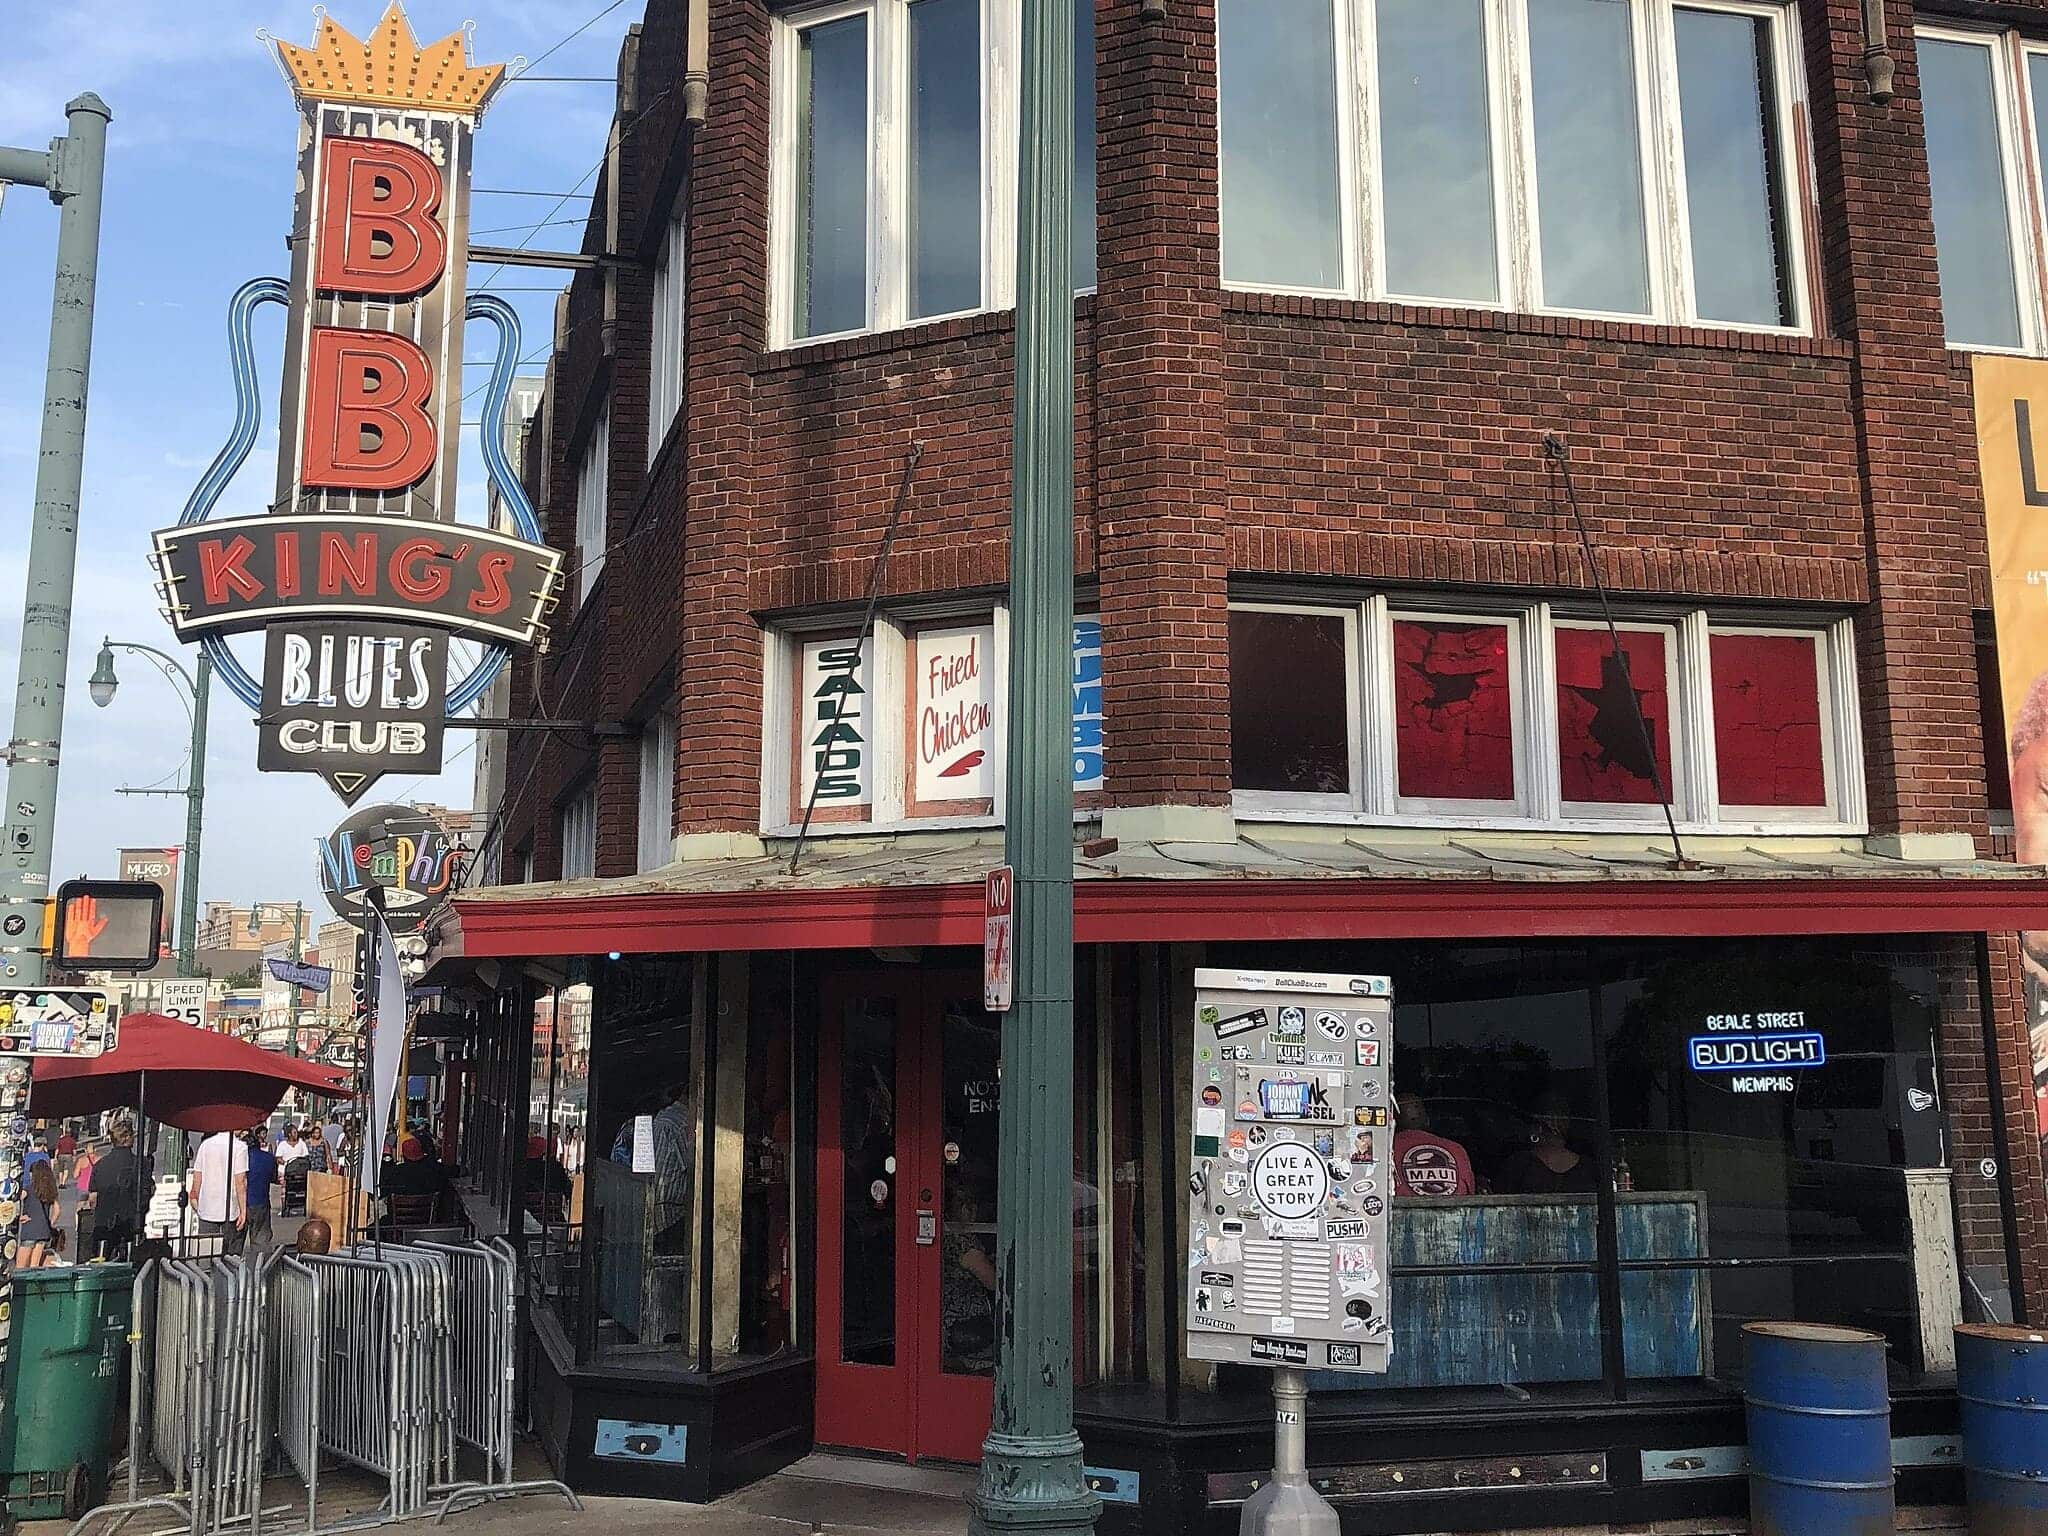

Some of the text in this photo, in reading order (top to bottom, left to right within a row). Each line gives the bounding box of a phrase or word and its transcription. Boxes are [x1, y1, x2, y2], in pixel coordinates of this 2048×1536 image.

[197, 530, 516, 616] KING'S
[281, 633, 433, 711] BLUES
[928, 636, 980, 700] Fried
[811, 646, 867, 800] SALADS
[278, 719, 427, 755] CLUB
[921, 701, 992, 765] Chicken
[314, 829, 465, 895] Memphis
[990, 876, 1008, 909] NO
[165, 984, 204, 995] SPEED
[168, 996, 199, 1006] LIMIT
[1318, 1016, 1345, 1038] 420
[1706, 1011, 1805, 1031] BEALE STREET
[1277, 1045, 1305, 1057] KUHS
[1695, 1040, 1819, 1066] BUD LIGHT
[1267, 1084, 1304, 1099] JOHNNY
[1732, 1076, 1795, 1094] MEMPHIS
[1269, 1098, 1303, 1113] MEANT
[1266, 1157, 1313, 1169] LIVE A
[1266, 1174, 1315, 1187] GREAT
[1409, 1169, 1455, 1180] MAUI
[1267, 1192, 1315, 1205] STORY
[1276, 1409, 1298, 1425] XYZ!
